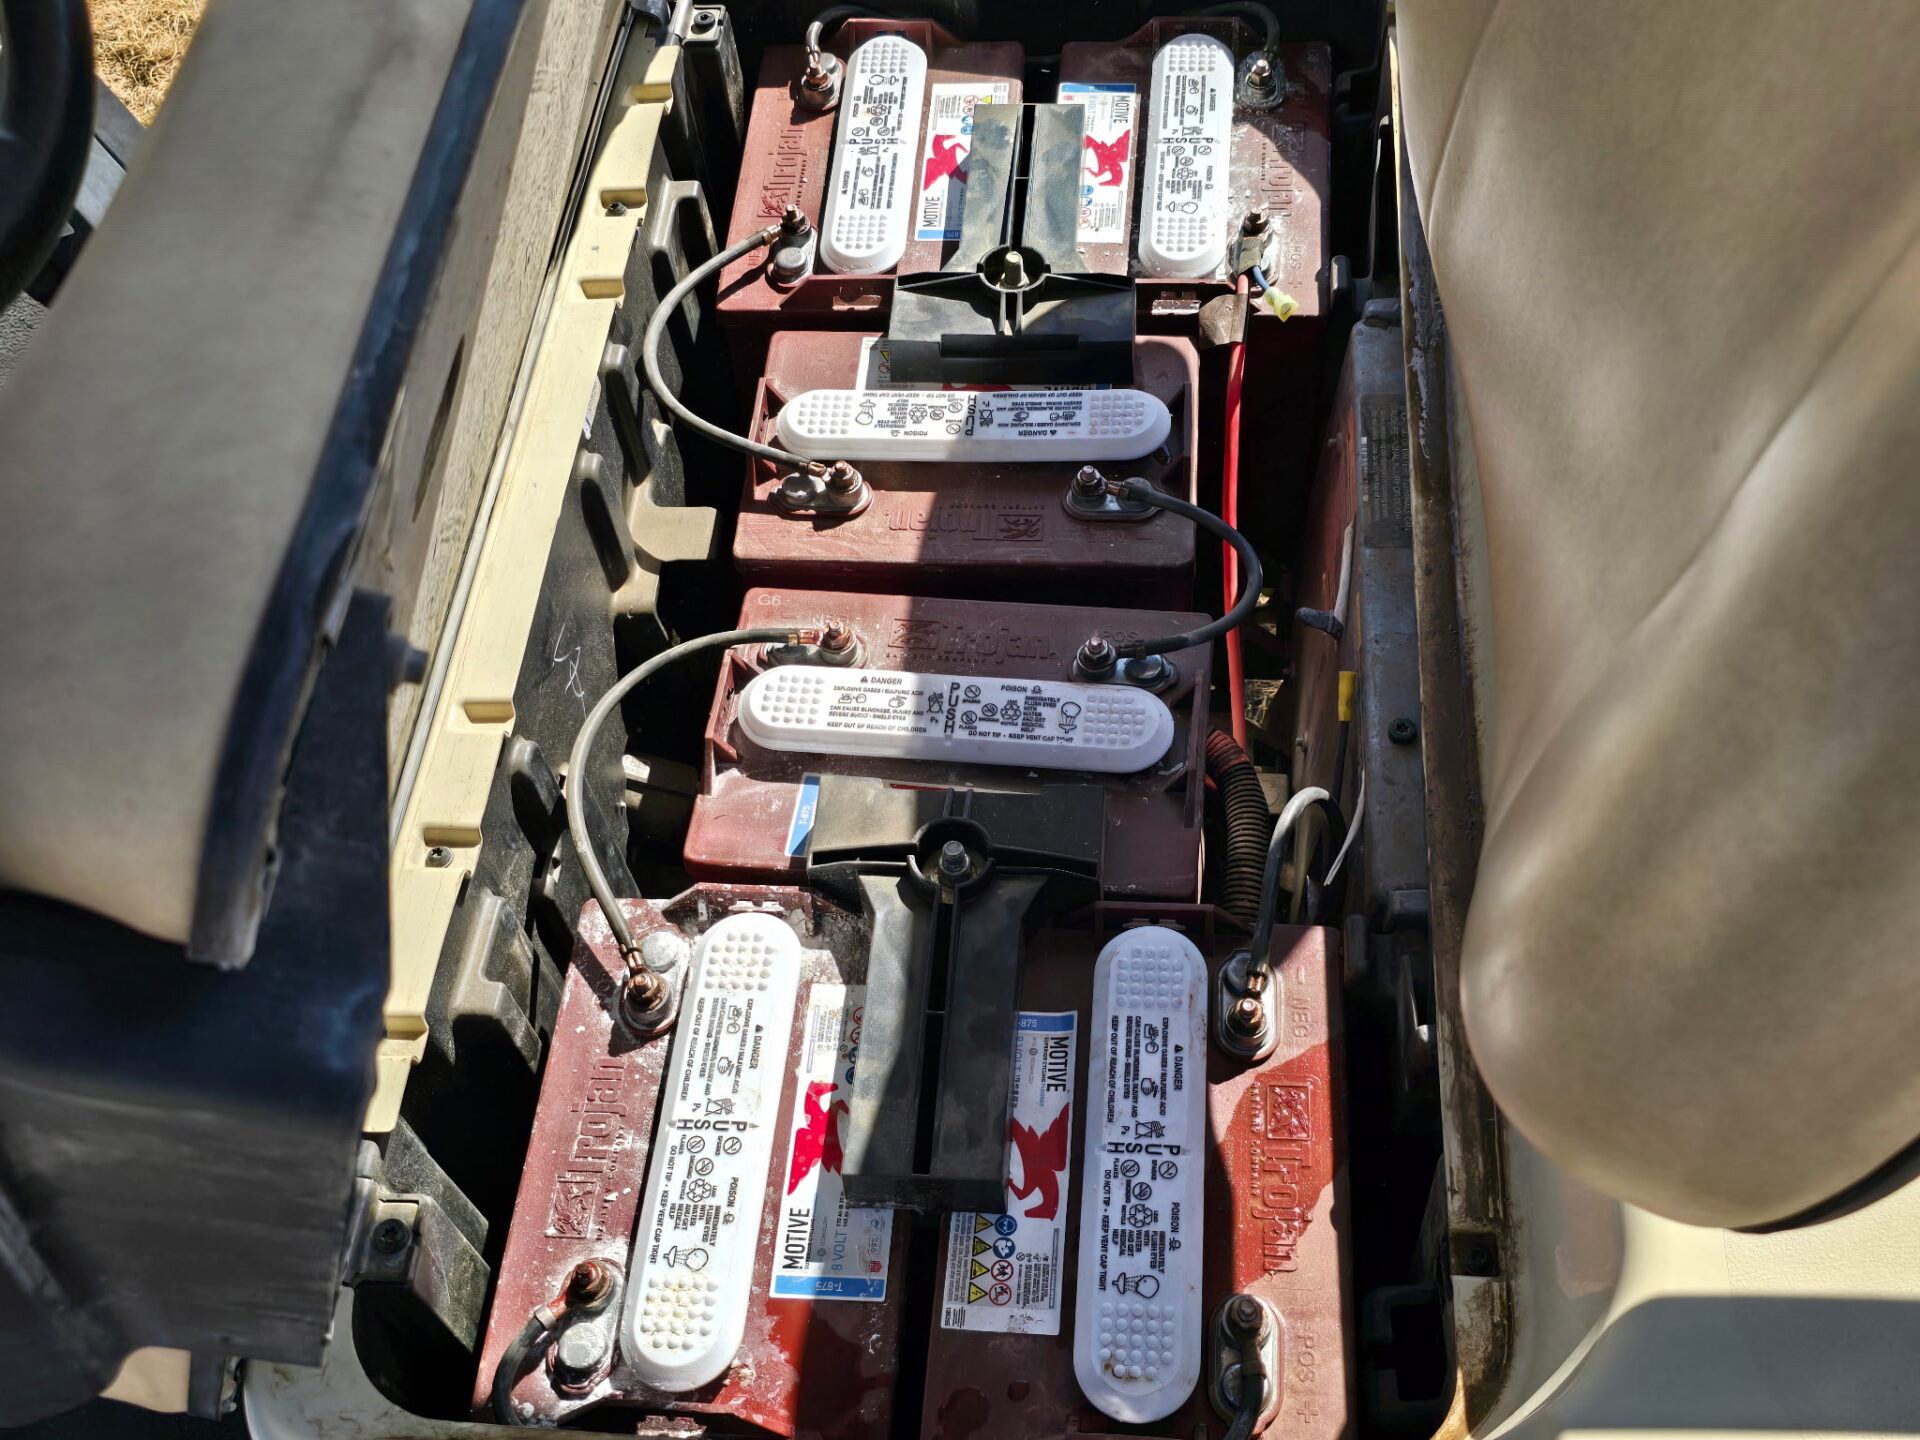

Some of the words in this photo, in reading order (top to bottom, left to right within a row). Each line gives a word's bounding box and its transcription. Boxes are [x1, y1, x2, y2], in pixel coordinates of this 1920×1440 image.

[1113, 95, 1131, 124] MOTIVE
[763, 128, 808, 192] Trojan
[922, 196, 940, 227] MOTIVE
[964, 395, 976, 435] PUSH
[888, 507, 995, 541] Trojan
[942, 626, 1050, 664] Trojan
[871, 676, 902, 684] DANGER
[1000, 684, 1028, 692] POISON
[944, 682, 960, 733] PUSH
[1017, 1019, 1037, 1027] -875
[1293, 997, 1309, 1037] NEG
[692, 1028, 699, 1036] OF
[686, 1059, 694, 1067] OF
[749, 1036, 761, 1068] DANGER
[1046, 1036, 1069, 1091] MOTIVE
[1110, 1047, 1116, 1055] OF
[1108, 1080, 1115, 1088] OF
[1173, 1056, 1182, 1090] DANGER
[564, 1056, 635, 1177] Trojan
[676, 1119, 747, 1131] PUSH
[1106, 1142, 1180, 1155] PUSH
[1104, 1169, 1110, 1179] DO
[659, 1189, 669, 1208] KEEP
[726, 1177, 738, 1207] POISON
[1251, 1141, 1311, 1271] Trojan
[656, 1209, 665, 1226] VENT
[1170, 1202, 1179, 1232] POISON
[653, 1228, 661, 1243] CAP
[779, 1207, 811, 1268] MOTIVE
[831, 1230, 847, 1261] VOLT
[870, 1236, 878, 1252] 99%
[815, 1280, 843, 1291] T-875
[1098, 1270, 1106, 1291] TIGHT
[1297, 1335, 1316, 1383] POS
